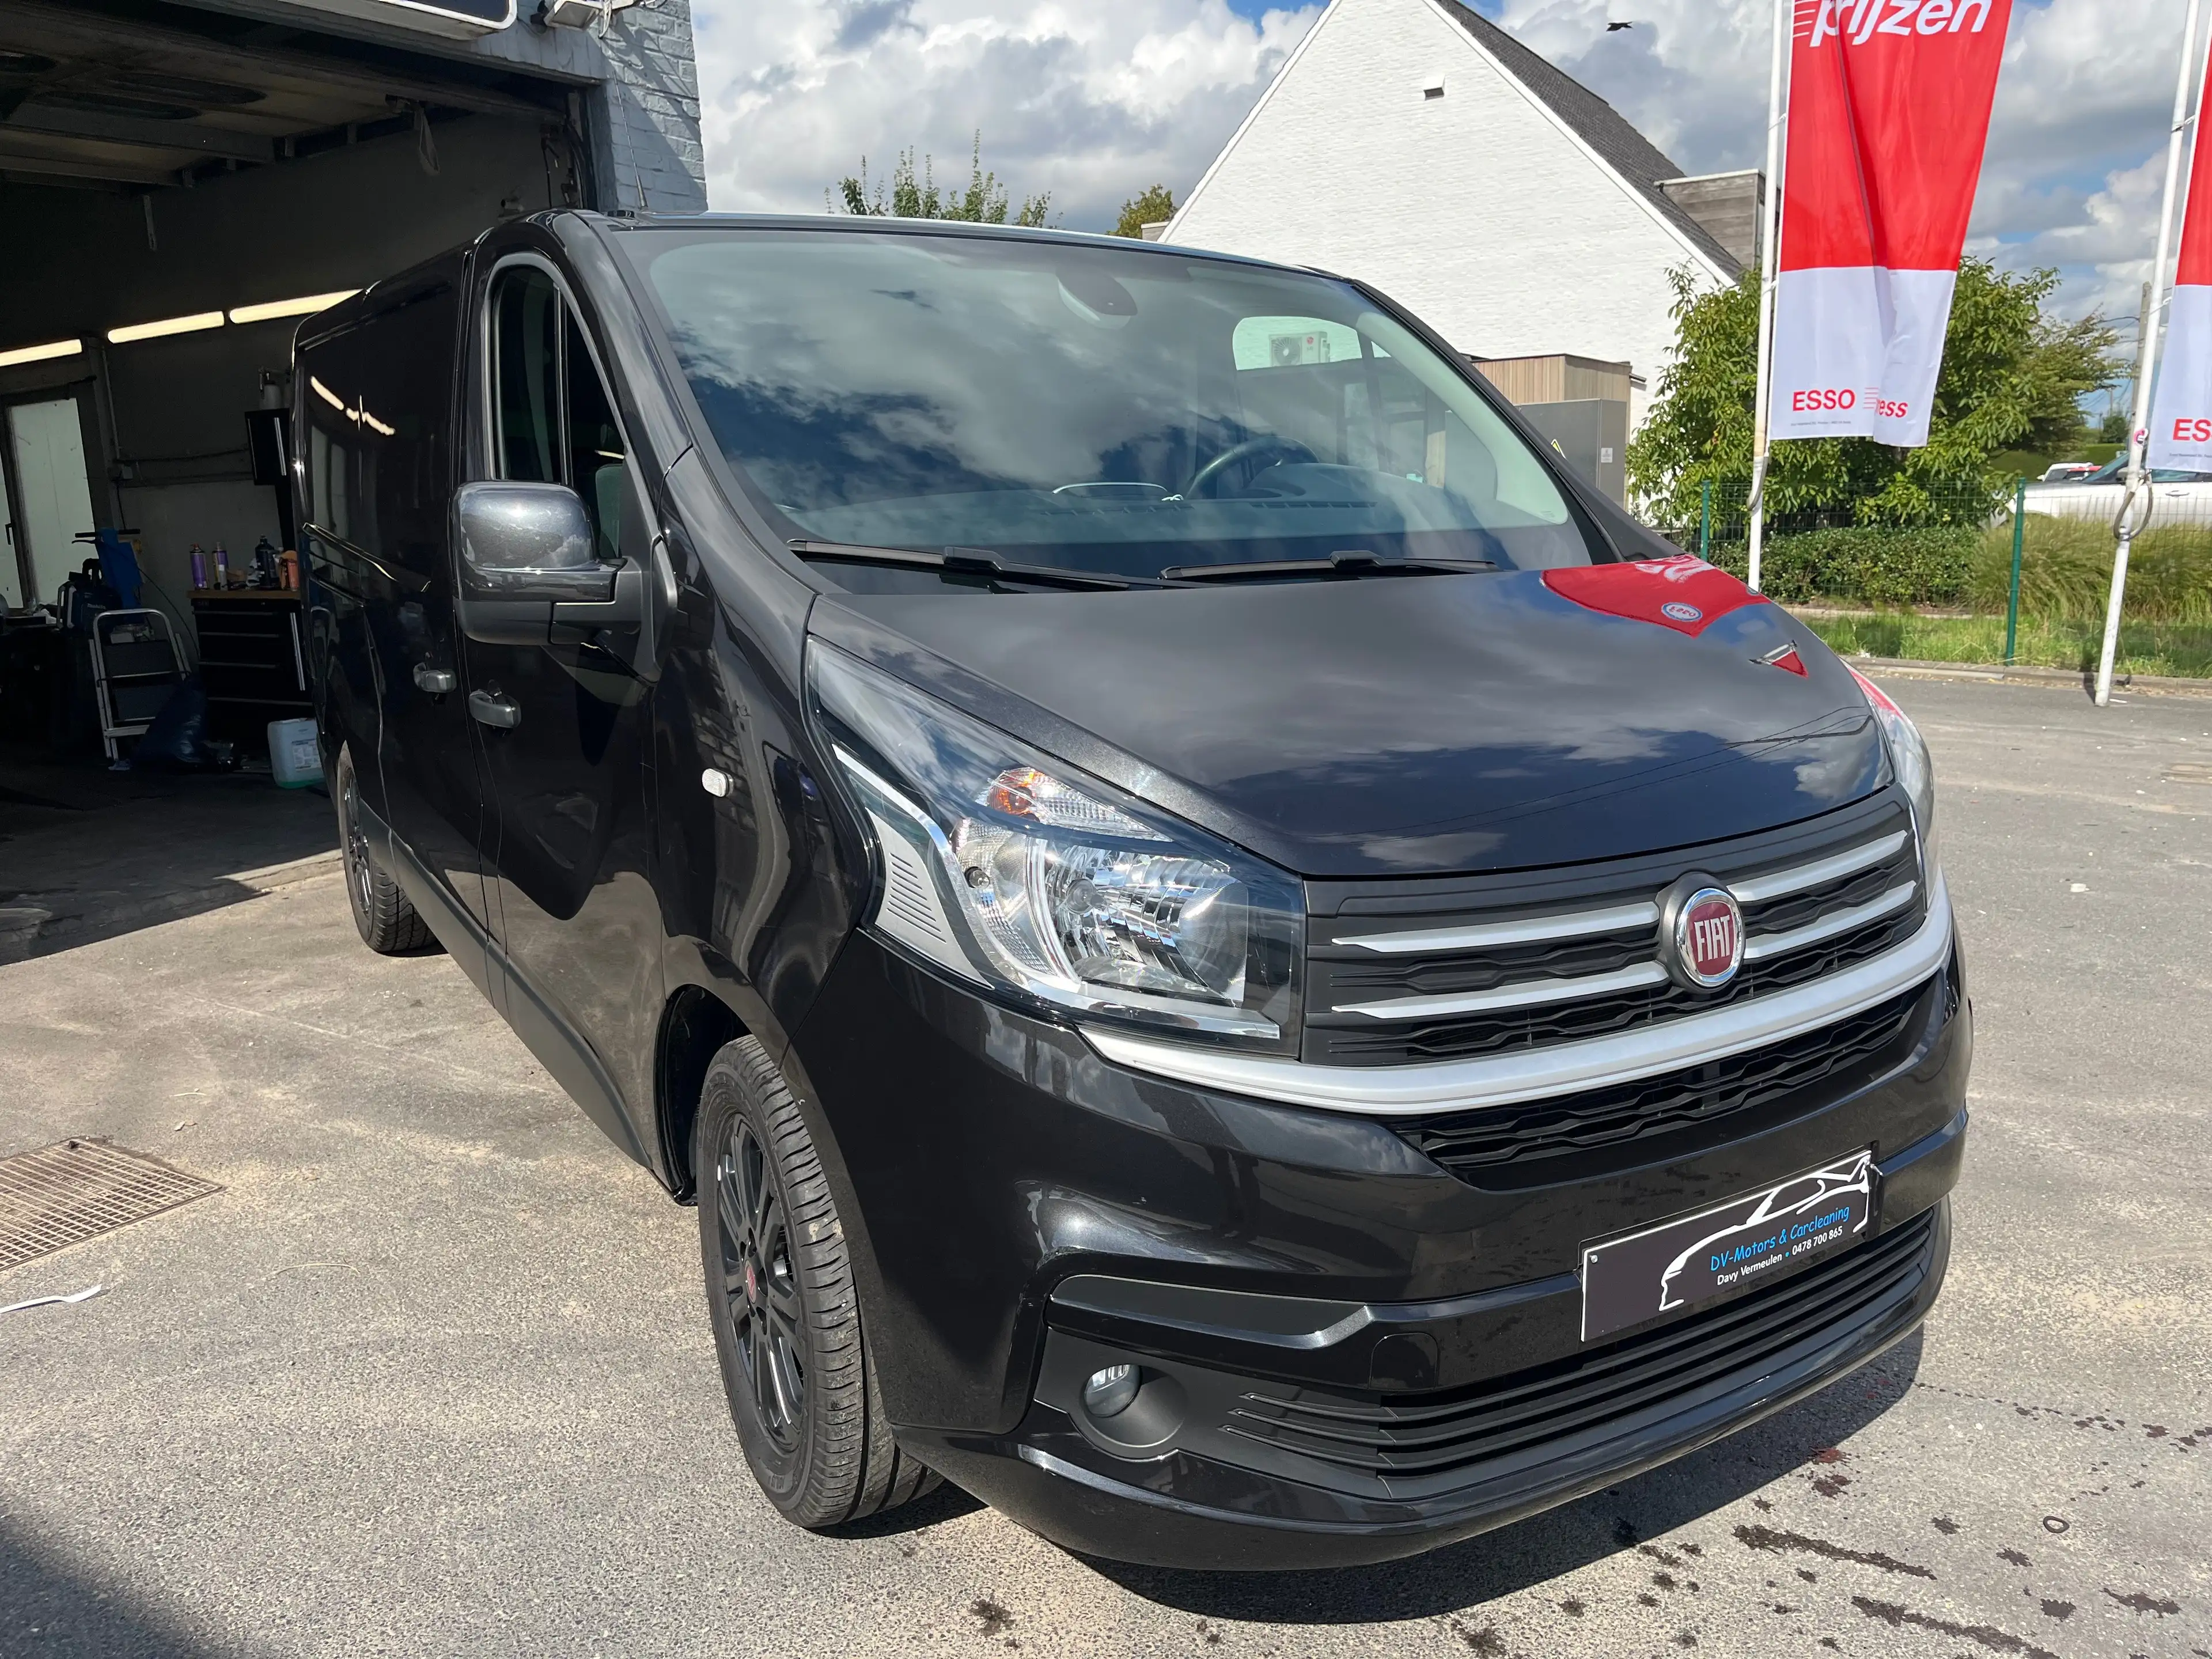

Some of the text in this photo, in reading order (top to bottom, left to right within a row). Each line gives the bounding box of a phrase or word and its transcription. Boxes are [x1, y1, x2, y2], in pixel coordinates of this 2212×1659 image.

[1792, 389, 1855, 411] ESSO
[1694, 915, 1730, 963] FIAT
[1710, 1206, 1850, 1271] DV-Motors & Carcleaning
[1717, 1225, 1843, 1286] Davy Vermeulen 0478 700 865
